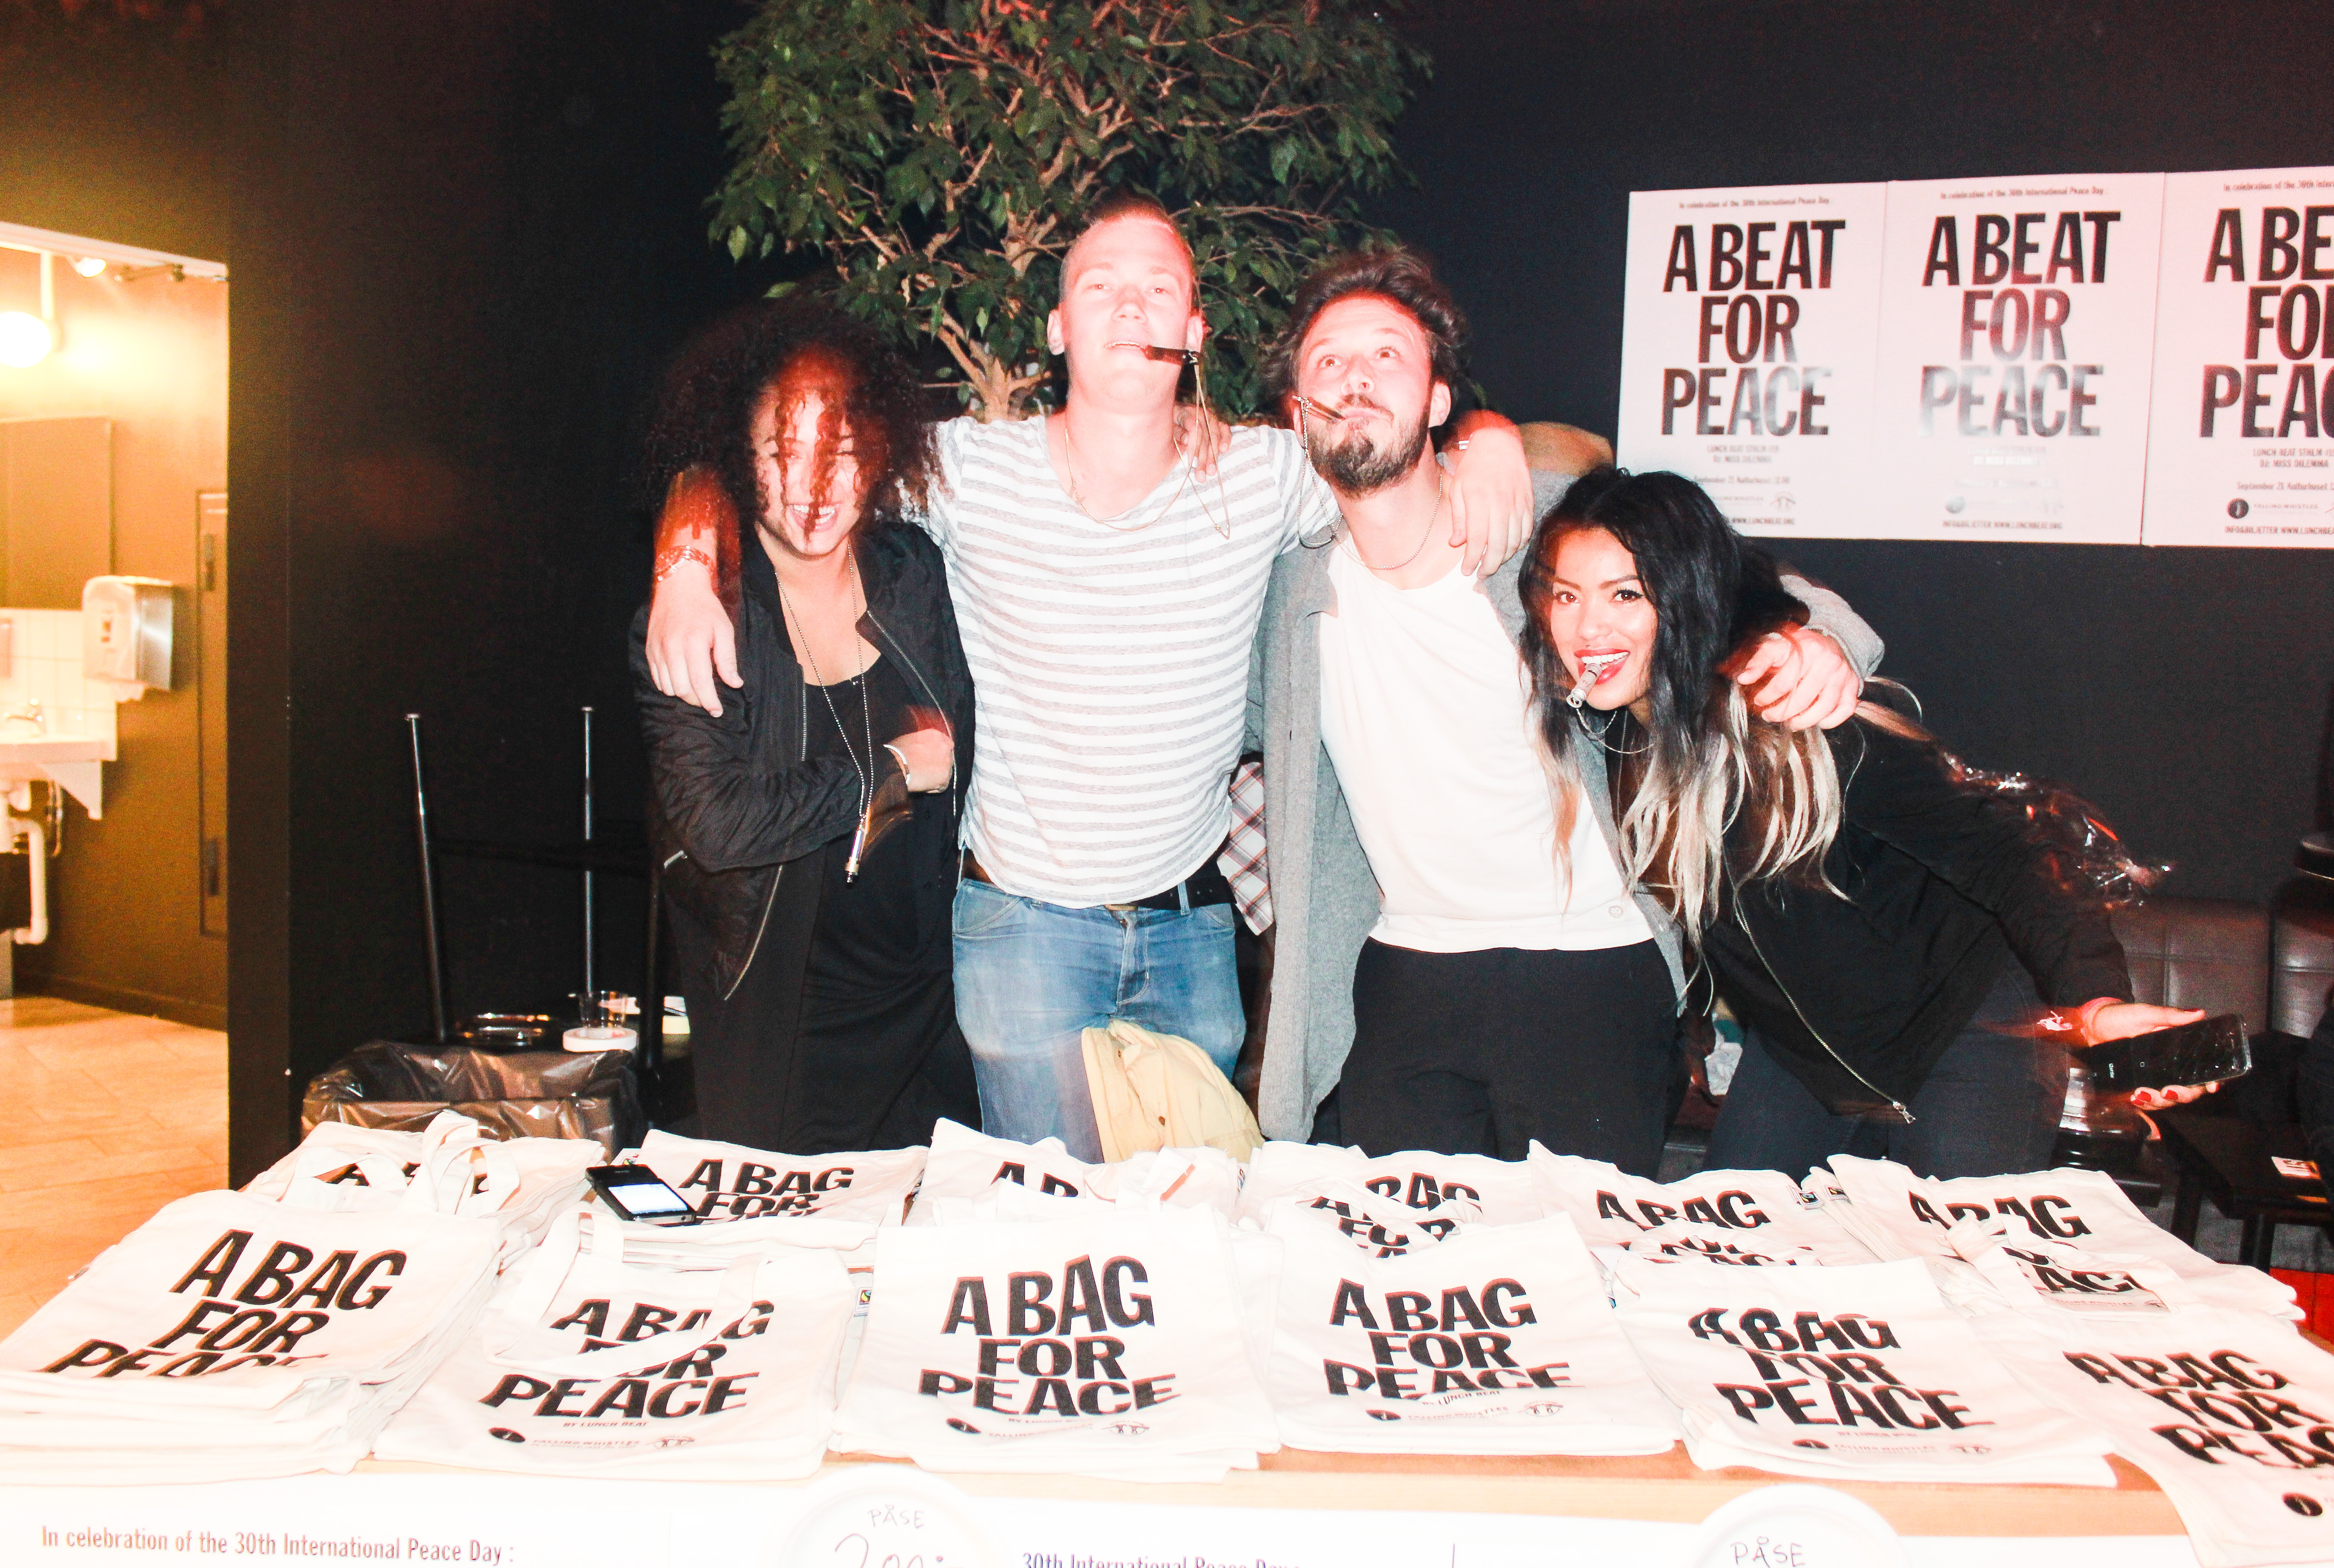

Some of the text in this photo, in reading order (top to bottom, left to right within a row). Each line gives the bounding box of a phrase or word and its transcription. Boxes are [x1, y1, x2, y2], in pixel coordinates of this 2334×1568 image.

[1663, 220, 1846, 292] A BEAT
[1922, 211, 2121, 286] A BEAT
[2203, 208, 2244, 282] A
[1697, 294, 1800, 363] FOR
[1960, 288, 2071, 363] FOR
[2244, 283, 2334, 360] FO
[1661, 367, 1833, 436] PEACE
[1918, 363, 2104, 437] PEACE
[677, 1159, 854, 1196] A BAG
[696, 1192, 819, 1217] FOR
[1908, 1190, 1952, 1230] A
[169, 1229, 407, 1311] A BAG
[941, 1254, 1155, 1336] A BAG
[1329, 1277, 1537, 1332] A BAG
[148, 1299, 329, 1353] FOR
[549, 1299, 610, 1337] A
[1688, 1307, 1901, 1352] A BAG
[979, 1336, 1127, 1380] FOR
[1367, 1331, 1520, 1369] FOR
[1745, 1349, 1907, 1385] FOR
[2062, 1349, 2296, 1391] A BAG
[477, 1372, 760, 1418] PEACE
[917, 1369, 1181, 1417] PEACE
[1323, 1358, 1585, 1401] PEACE
[1438, 1392, 1472, 1406] LUNCH
[1712, 1378, 1996, 1430] PEACE
[2142, 1388, 2330, 1432] FOR
[867, 1504, 924, 1529] PÅSE
[42, 1525, 59, 1547] In
[66, 1527, 168, 1552] celebration
[175, 1530, 192, 1553] of
[199, 1531, 227, 1554] the
[235, 1532, 276, 1555] 30th
[284, 1533, 400, 1559] International
[407, 1538, 461, 1562] Peace
[469, 1539, 503, 1566] Day
[1730, 1536, 1805, 1568] PÅSE
